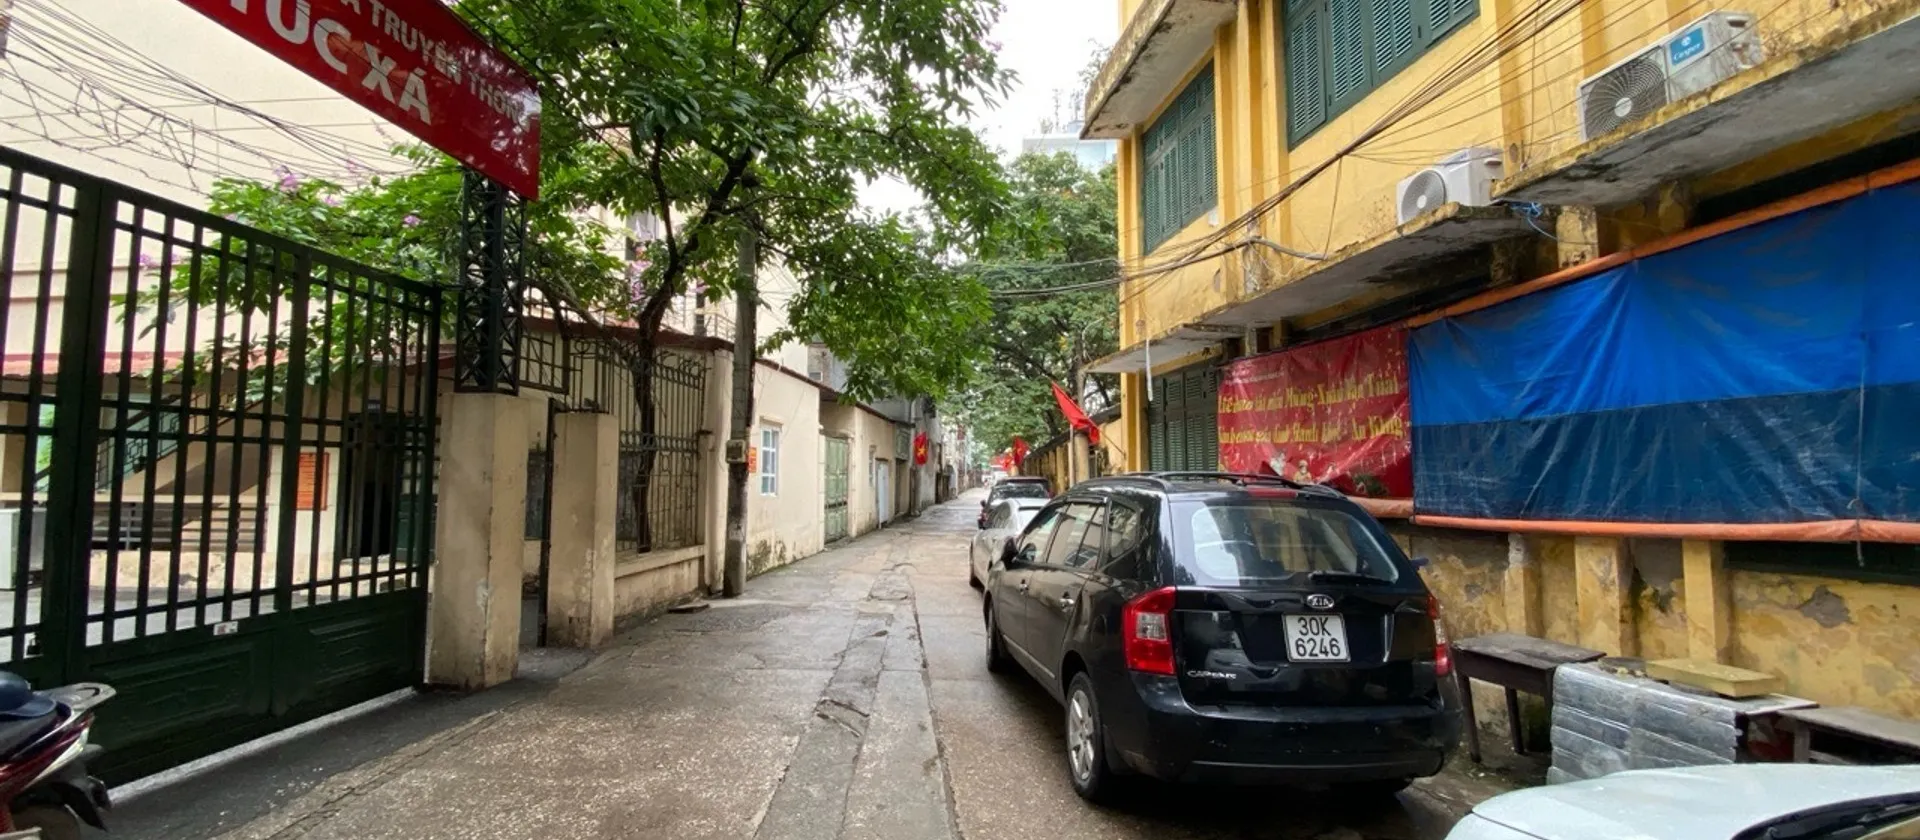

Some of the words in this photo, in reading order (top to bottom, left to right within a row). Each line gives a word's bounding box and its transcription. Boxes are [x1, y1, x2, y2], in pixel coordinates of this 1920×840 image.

[361, 41, 432, 126] XÁ
[1310, 596, 1331, 607] KIA
[1297, 616, 1332, 636] 30K
[1295, 638, 1341, 657] 6246
